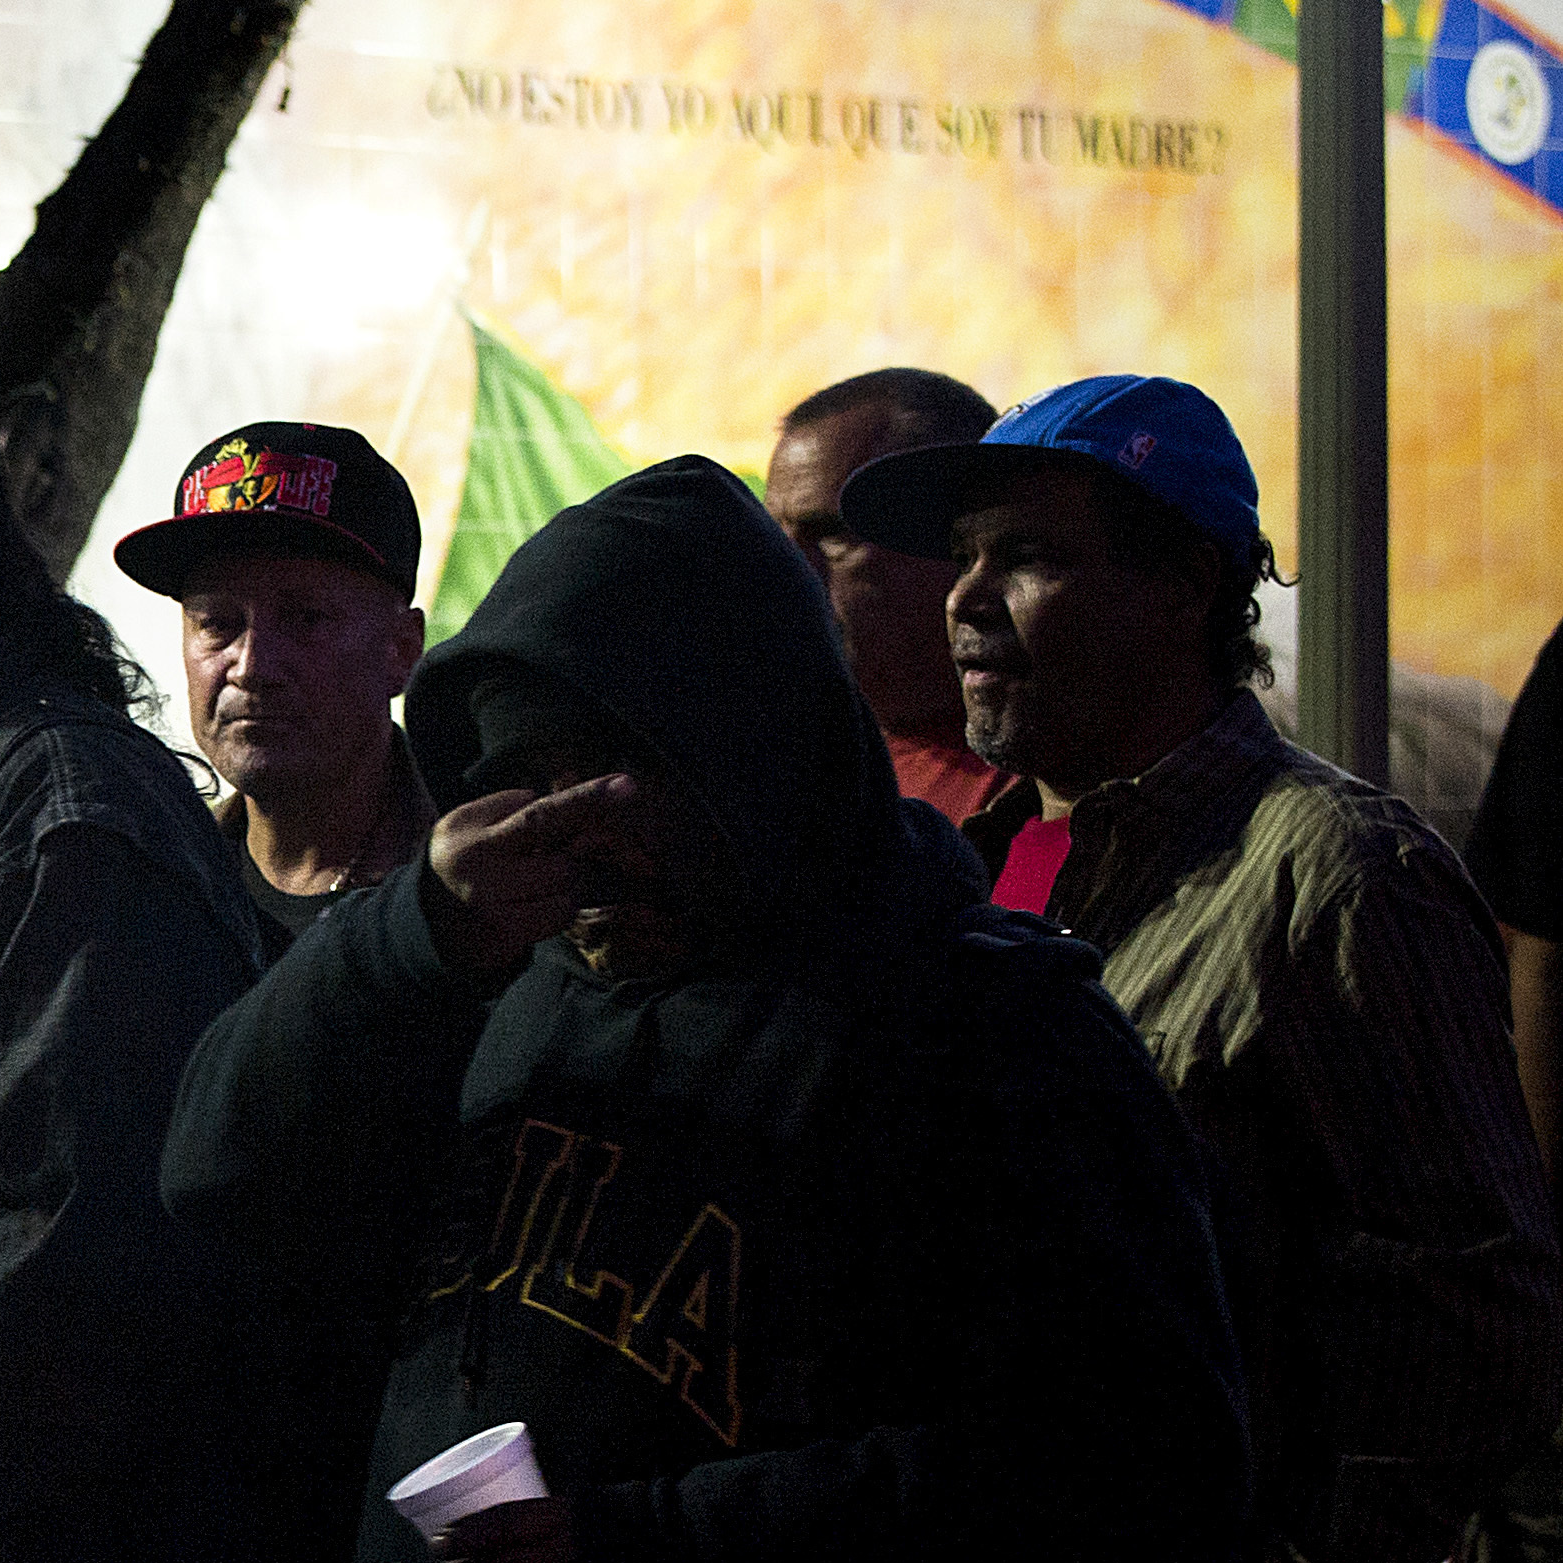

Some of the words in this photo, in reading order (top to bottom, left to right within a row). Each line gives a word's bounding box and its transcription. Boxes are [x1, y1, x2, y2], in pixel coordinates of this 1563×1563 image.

[520, 71, 644, 132] ESTOY
[661, 80, 719, 137] YO
[840, 94, 926, 161] QUE
[936, 99, 1002, 160] SOY
[1014, 107, 1061, 165] TU
[1072, 110, 1230, 176] MADRE?
